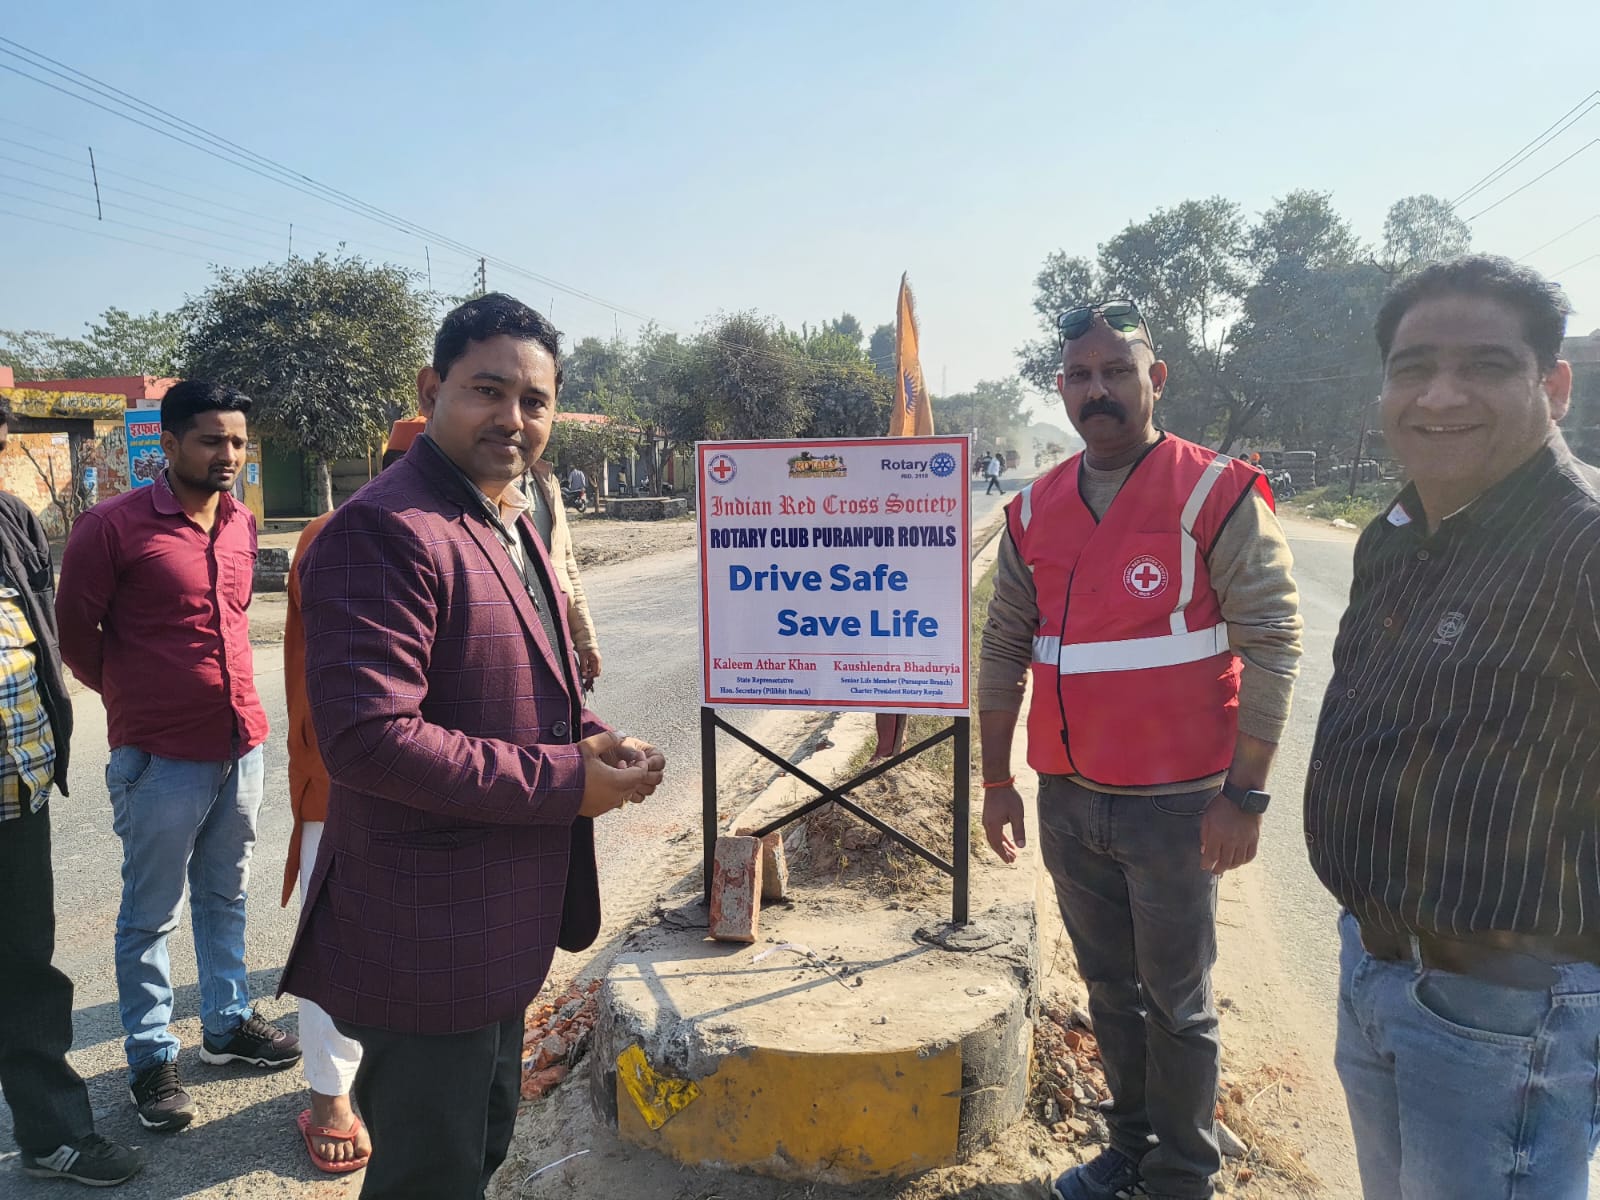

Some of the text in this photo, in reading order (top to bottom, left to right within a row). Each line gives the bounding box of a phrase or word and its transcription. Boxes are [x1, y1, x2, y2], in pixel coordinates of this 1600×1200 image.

[881, 459, 928, 472] Rotary
[710, 493, 957, 517] Indian Red Cross Society
[711, 525, 956, 549] ROTARY CLUB PURANPUR ROYALS
[729, 563, 908, 592] Drive Safe
[777, 609, 939, 638] Save Life
[713, 658, 817, 671] Kaleem Athar Khan
[834, 661, 960, 676] Kaushlendra Bhaduryia
[735, 687, 761, 695] Secretary
[873, 687, 900, 695] President
